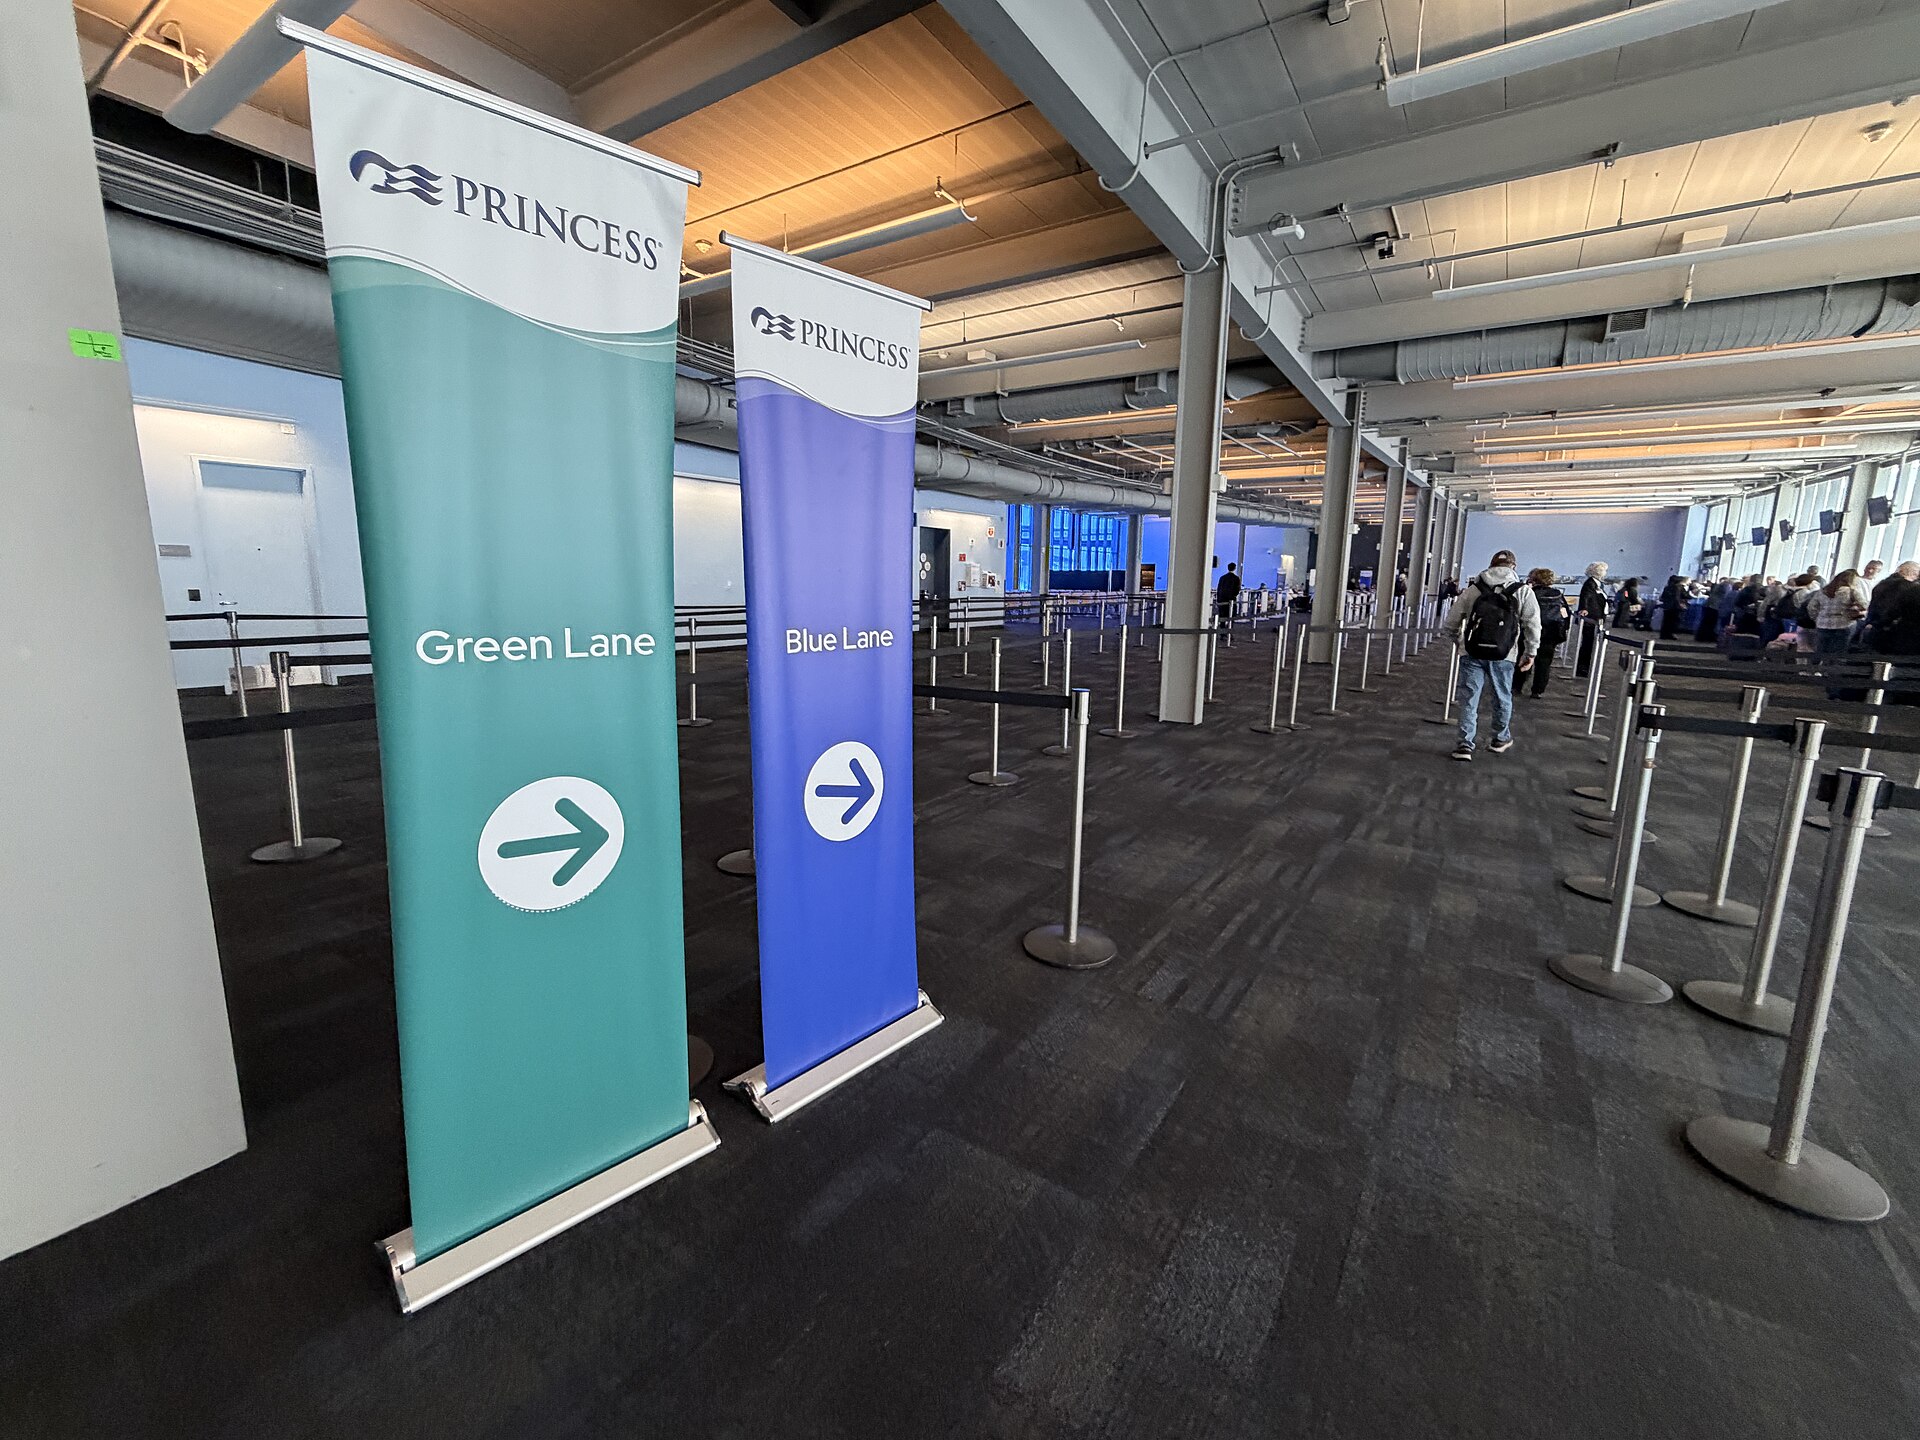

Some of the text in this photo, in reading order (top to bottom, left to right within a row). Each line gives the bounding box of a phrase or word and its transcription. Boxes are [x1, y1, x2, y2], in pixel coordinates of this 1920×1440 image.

[452, 174, 660, 271] PRINCESS
[800, 318, 910, 370] PRINCESS
[416, 628, 657, 666] Green Lane
[785, 627, 894, 655] Blue Lane
